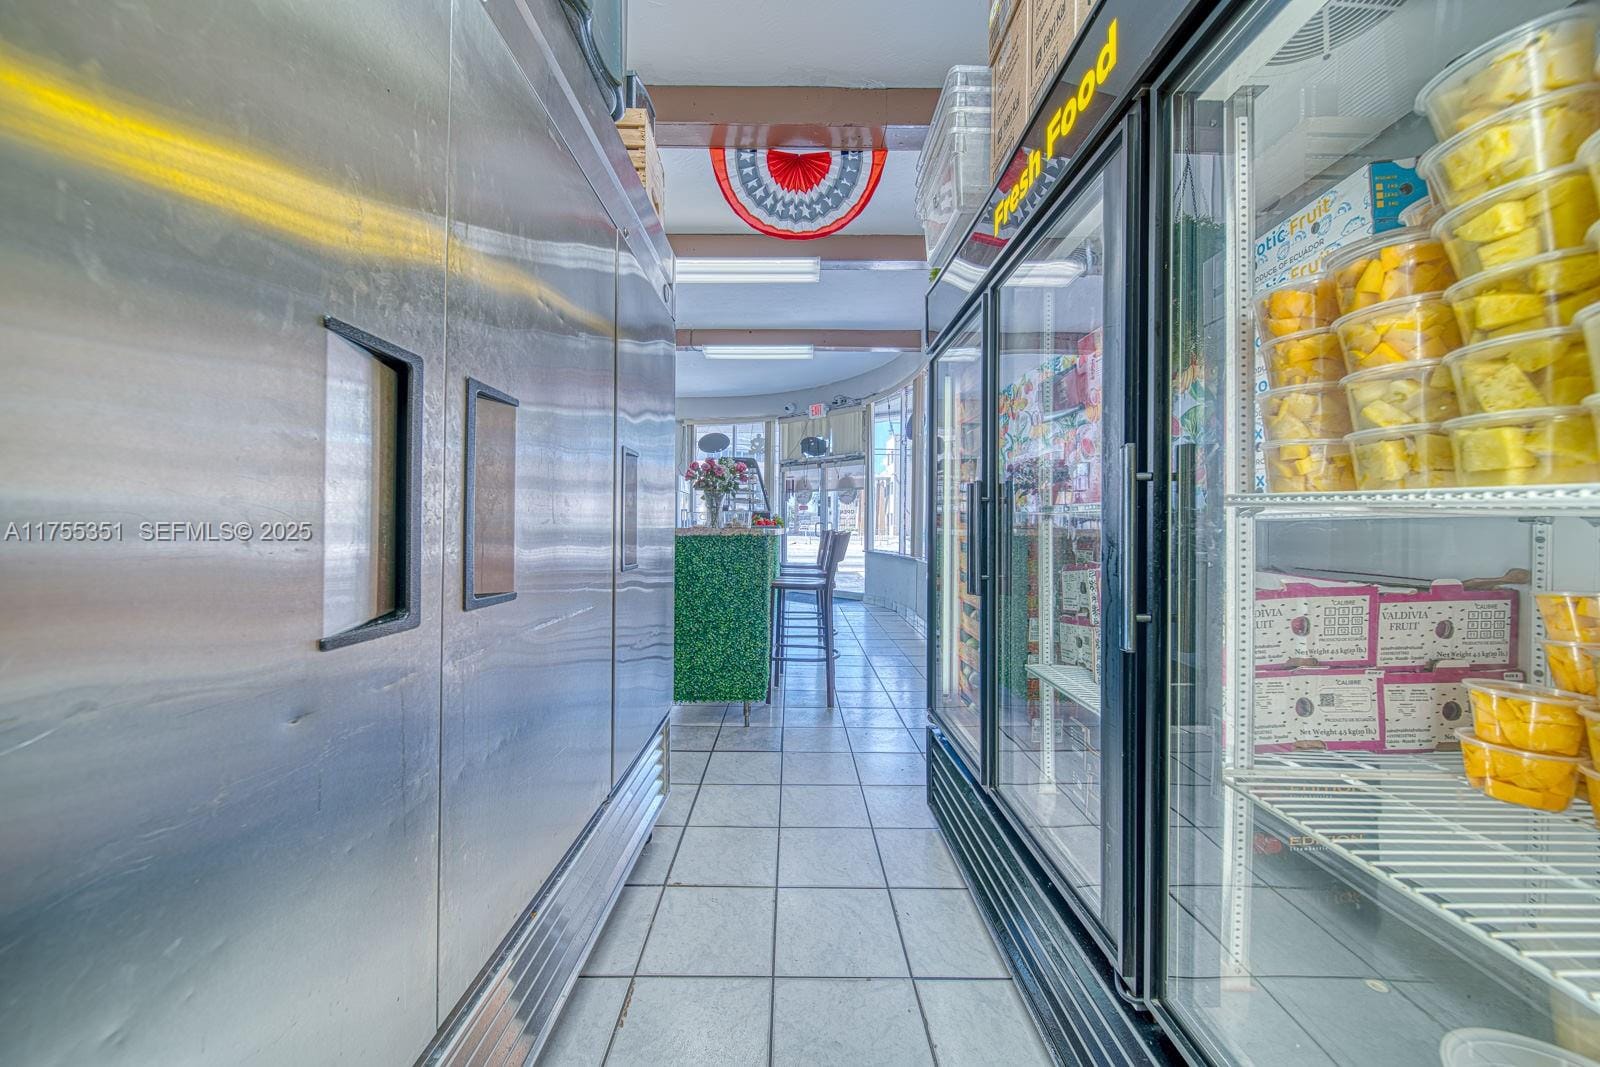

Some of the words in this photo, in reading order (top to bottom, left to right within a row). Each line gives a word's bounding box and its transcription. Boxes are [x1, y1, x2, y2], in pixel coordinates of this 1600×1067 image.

[994, 150, 1041, 237] Fresh
[1046, 17, 1118, 160] Food
[1290, 196, 1331, 235] Fruit
[1279, 259, 1289, 270] OF
[811, 404, 822, 417] EXIT
[1382, 610, 1429, 620] VALDIVIA
[1389, 621, 1418, 631] FRUIT
[1309, 648, 1329, 657] Weight
[1312, 728, 1337, 737] Weight
